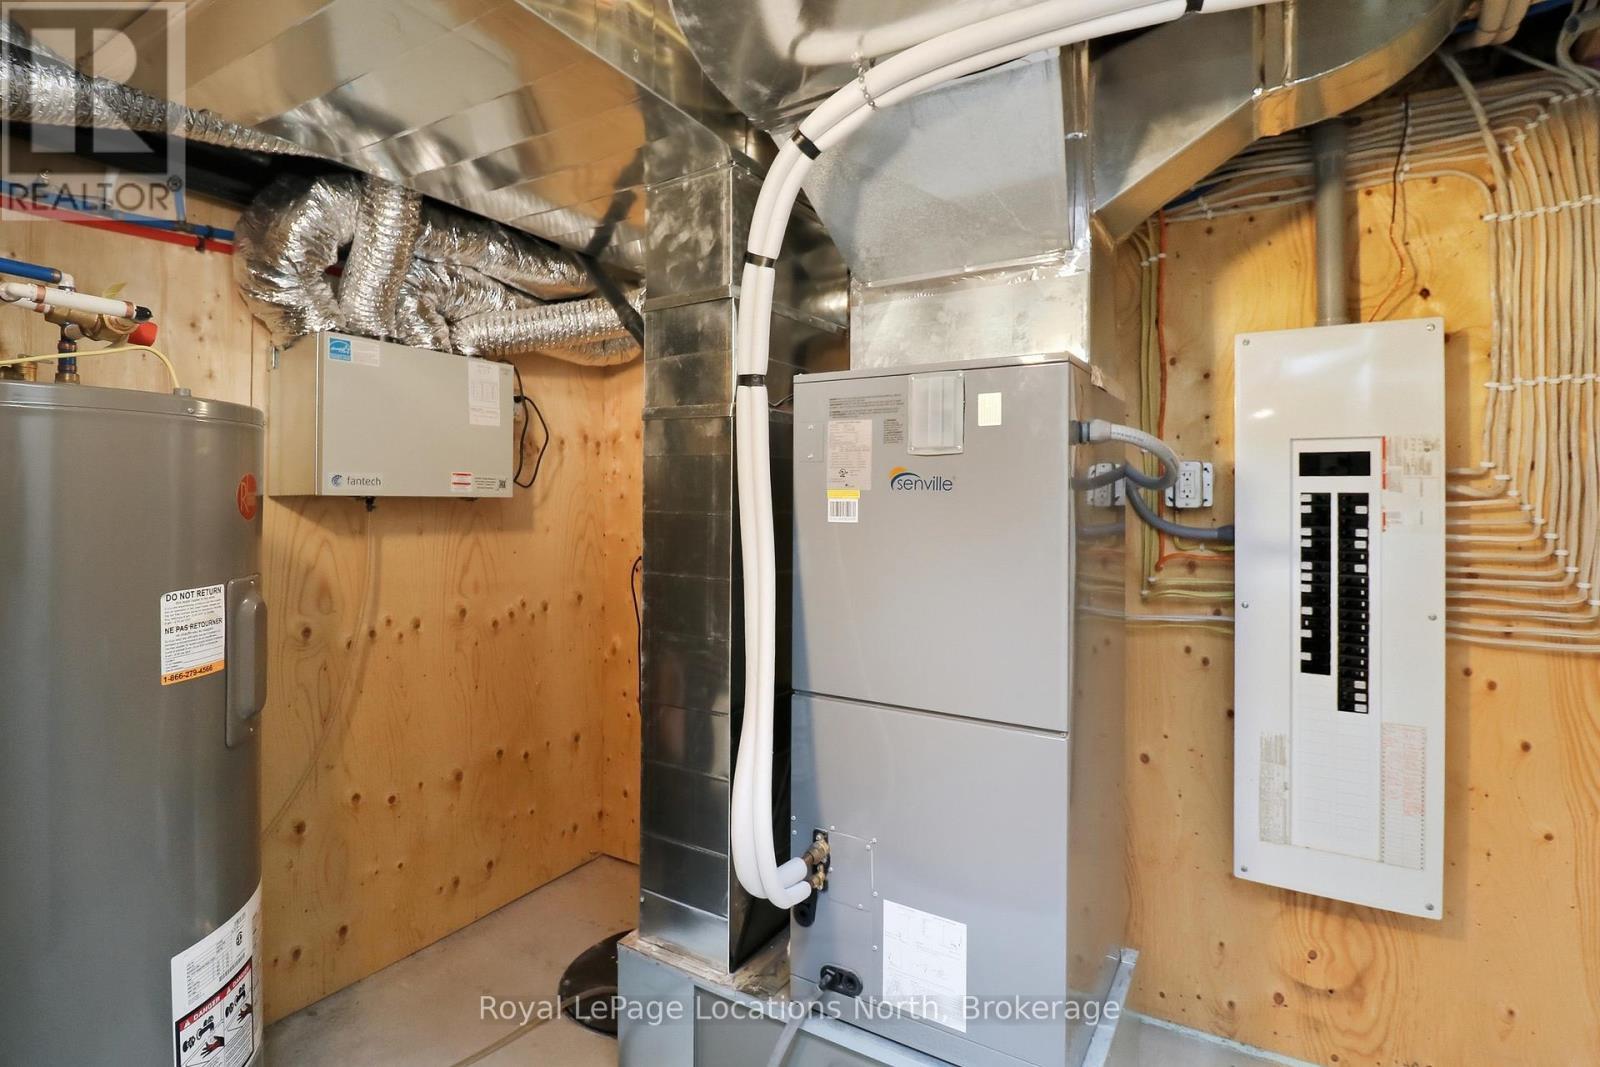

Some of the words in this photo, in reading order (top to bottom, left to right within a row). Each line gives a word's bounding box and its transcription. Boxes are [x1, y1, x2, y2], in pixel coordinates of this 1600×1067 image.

[346, 476, 382, 487] fantech
[896, 475, 953, 492] senville
[165, 593, 178, 602] DO
[179, 590, 195, 600] NOT
[196, 586, 222, 597] RETURN
[164, 626, 174, 635] NE
[175, 624, 189, 633] PAS
[189, 617, 223, 630] RETOURNER
[192, 995, 222, 1021] DANGER
